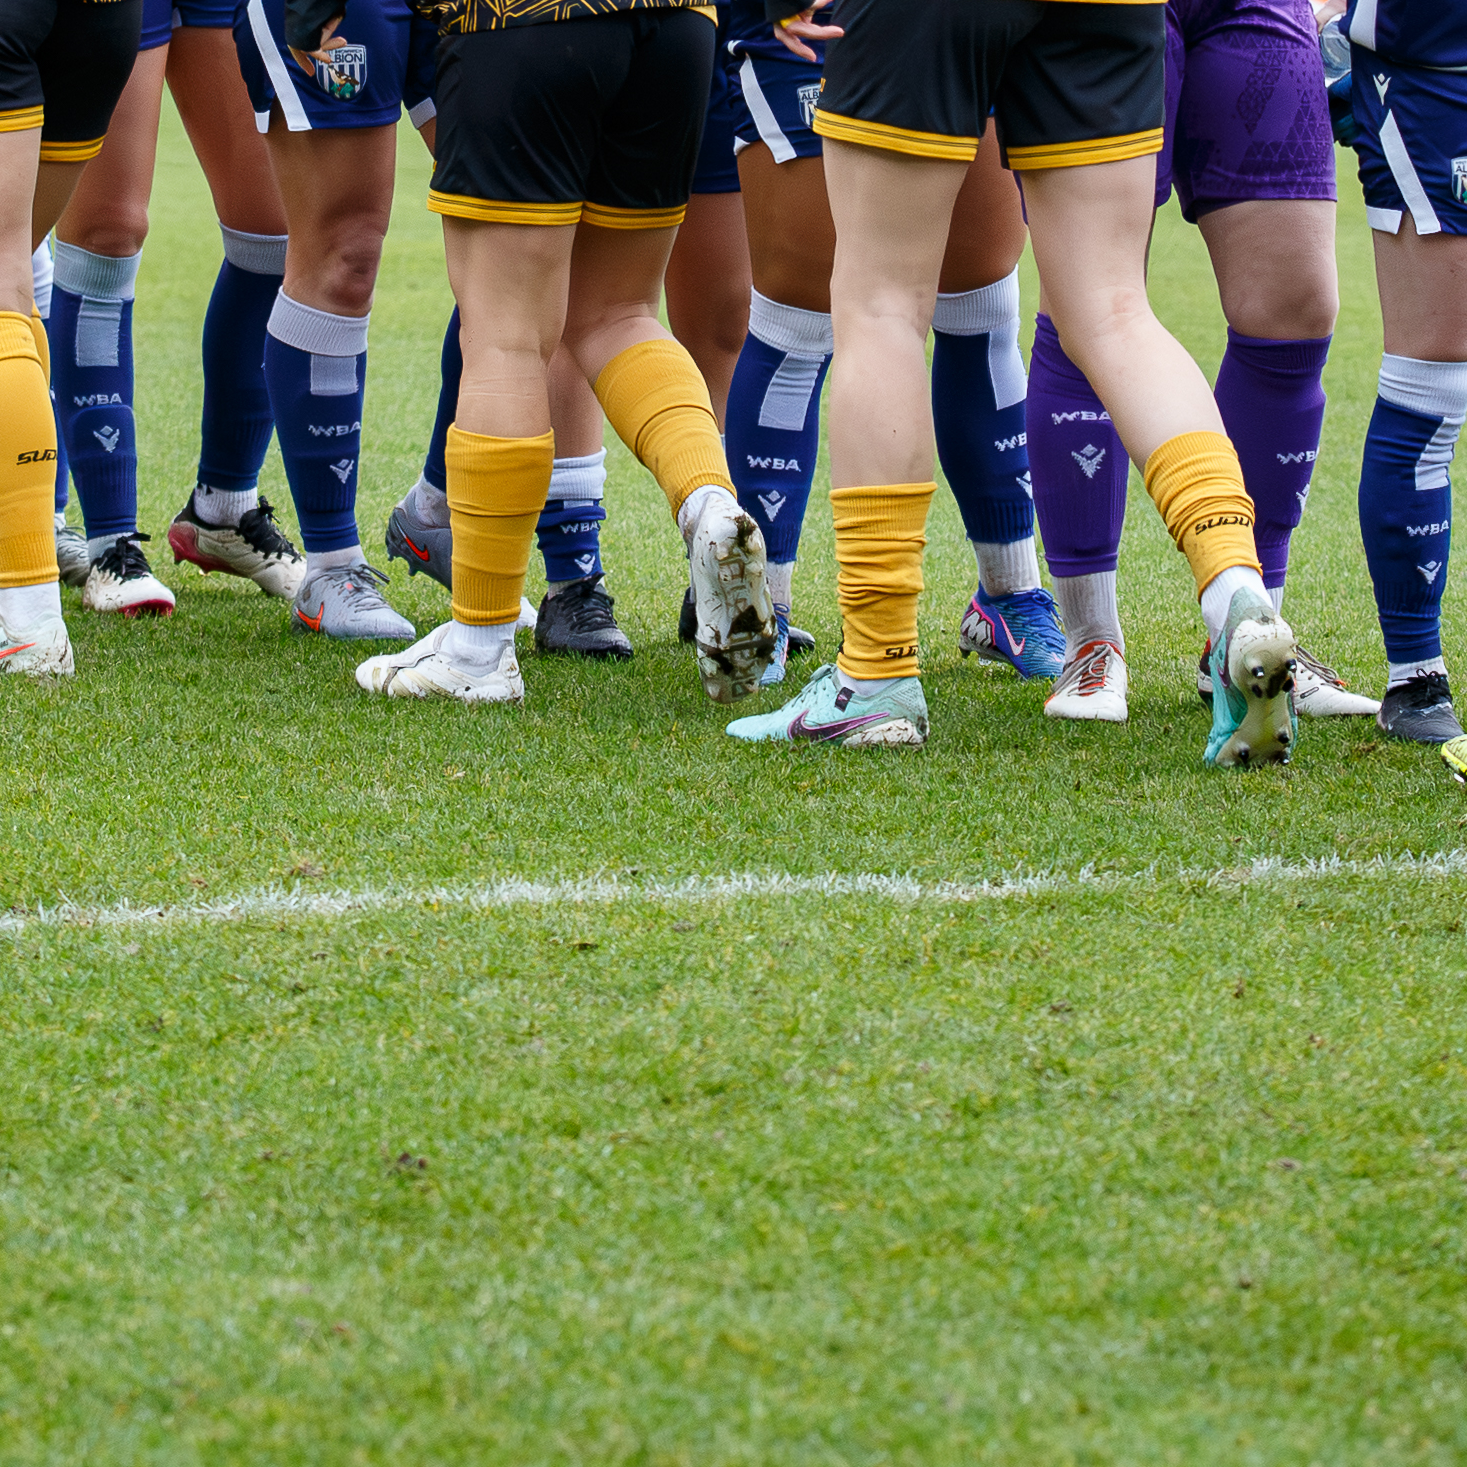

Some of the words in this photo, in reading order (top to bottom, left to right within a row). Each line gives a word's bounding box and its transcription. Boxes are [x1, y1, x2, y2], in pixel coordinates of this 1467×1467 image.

[74, 393, 122, 407] WBA
[308, 421, 361, 437] WBA
[747, 455, 801, 472] WBA
[560, 521, 600, 534] WBA
[1195, 516, 1250, 536] SUDU
[1406, 519, 1449, 537] WBA
